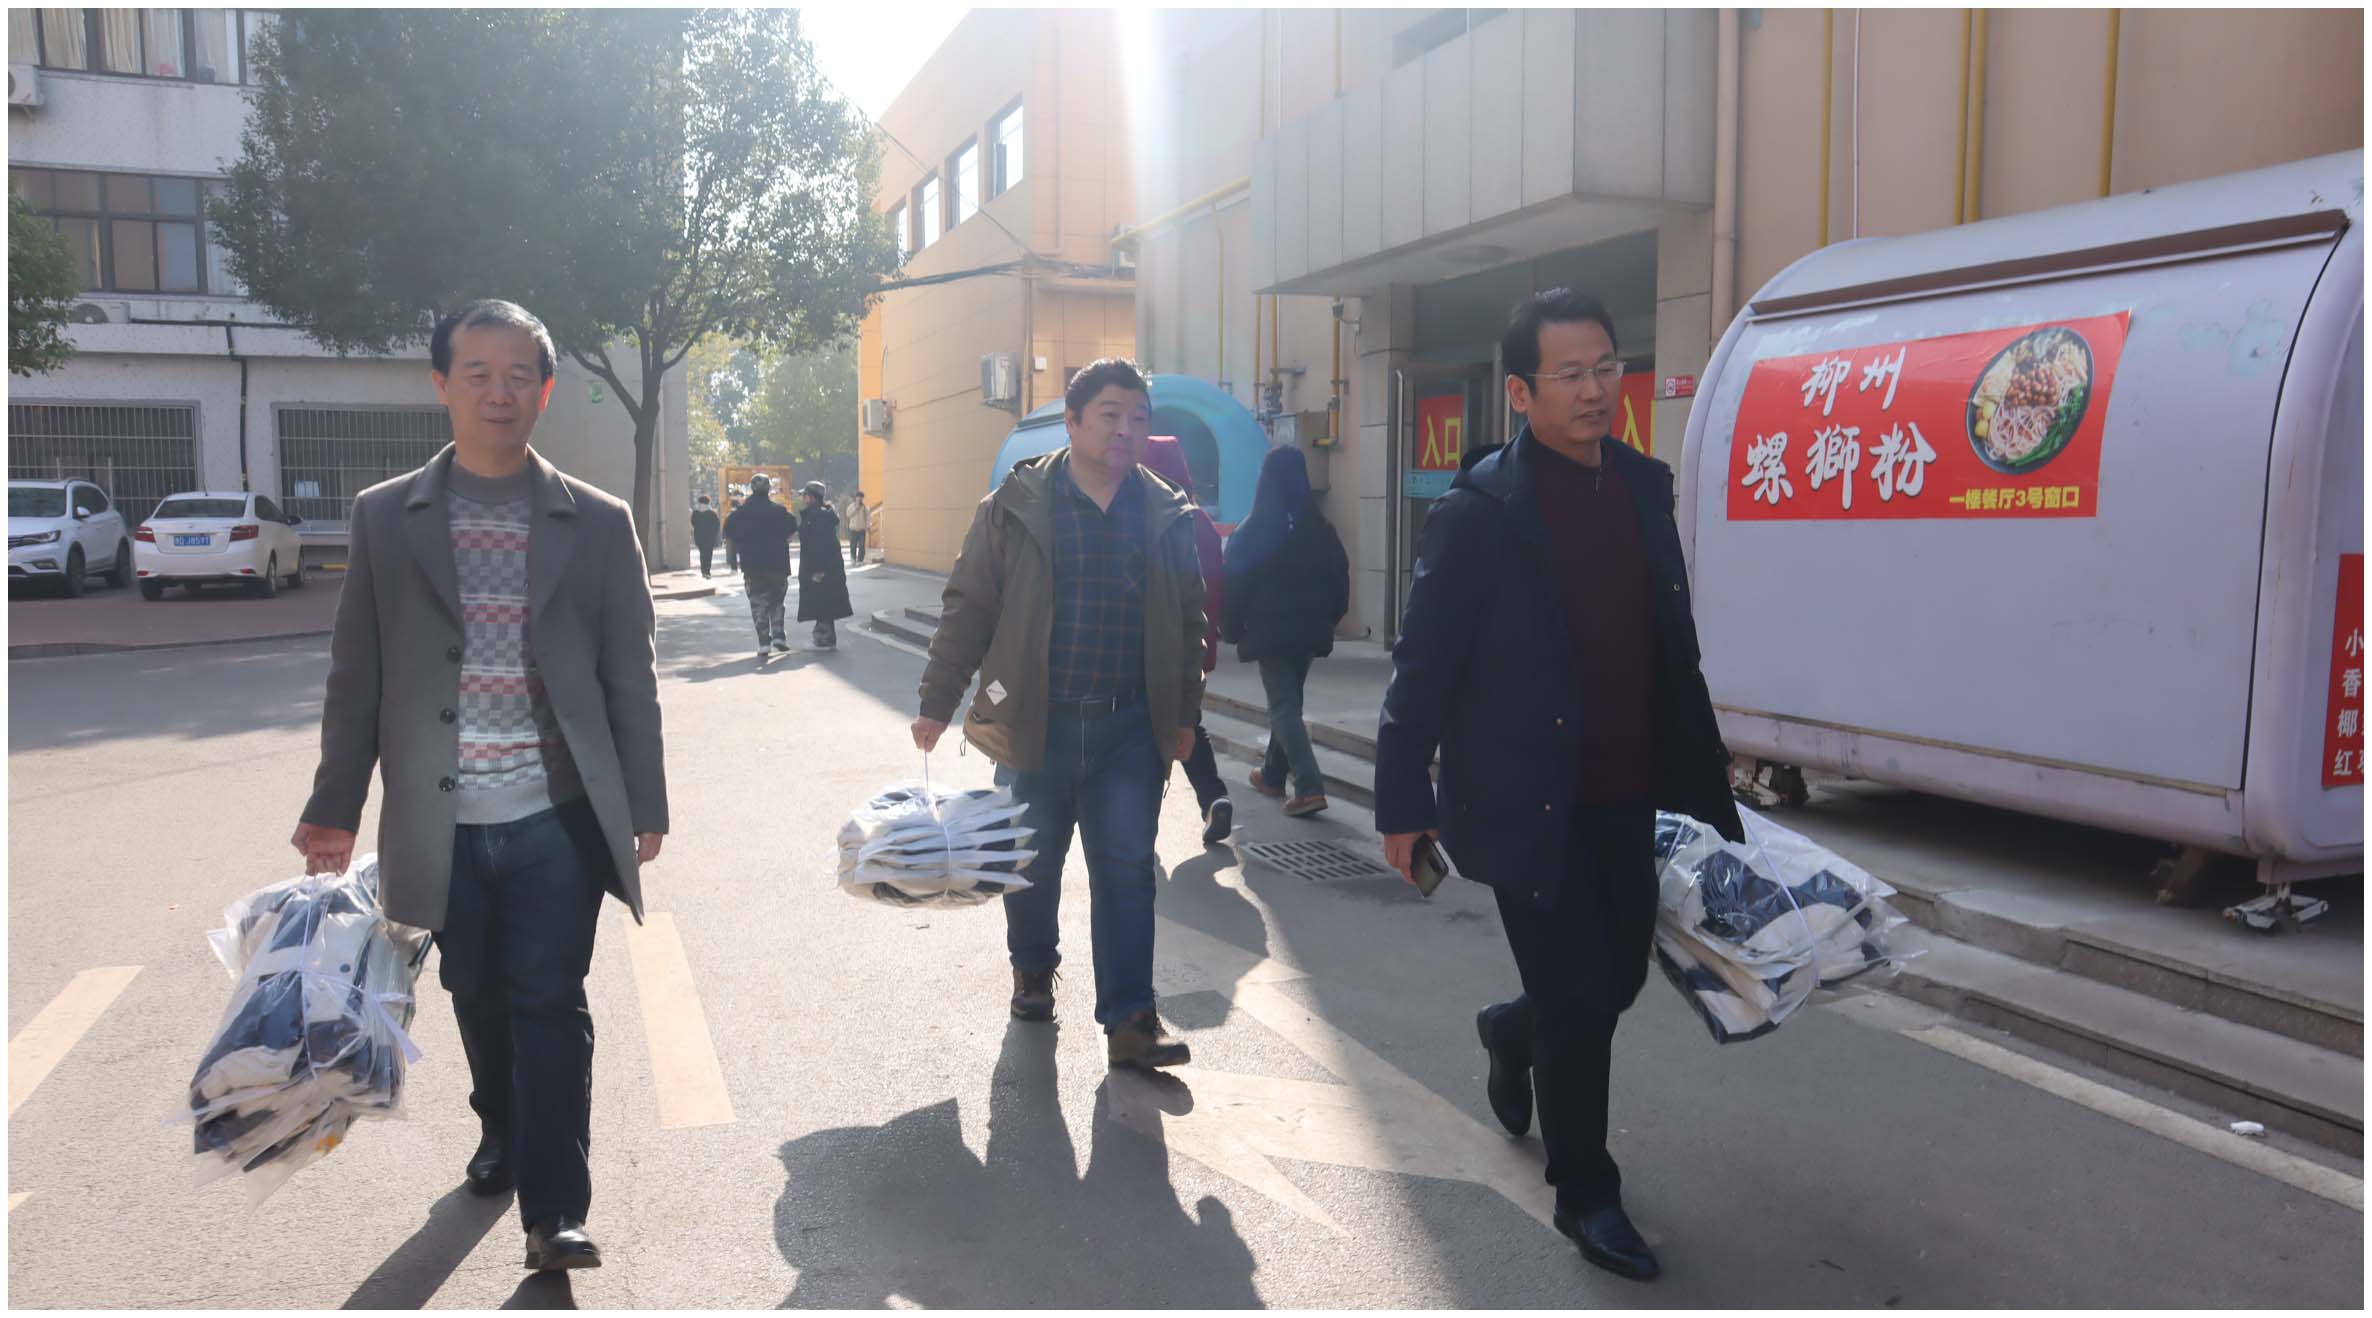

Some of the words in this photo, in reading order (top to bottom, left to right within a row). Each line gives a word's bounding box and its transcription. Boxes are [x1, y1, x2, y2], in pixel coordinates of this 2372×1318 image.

[1801, 346, 1906, 416] 柳州
[1423, 415, 1461, 467] 入口
[1622, 394, 1656, 457] 入
[1949, 486, 2080, 510] 一楼餐厅3号窗口
[2337, 708, 2364, 737] 椰
